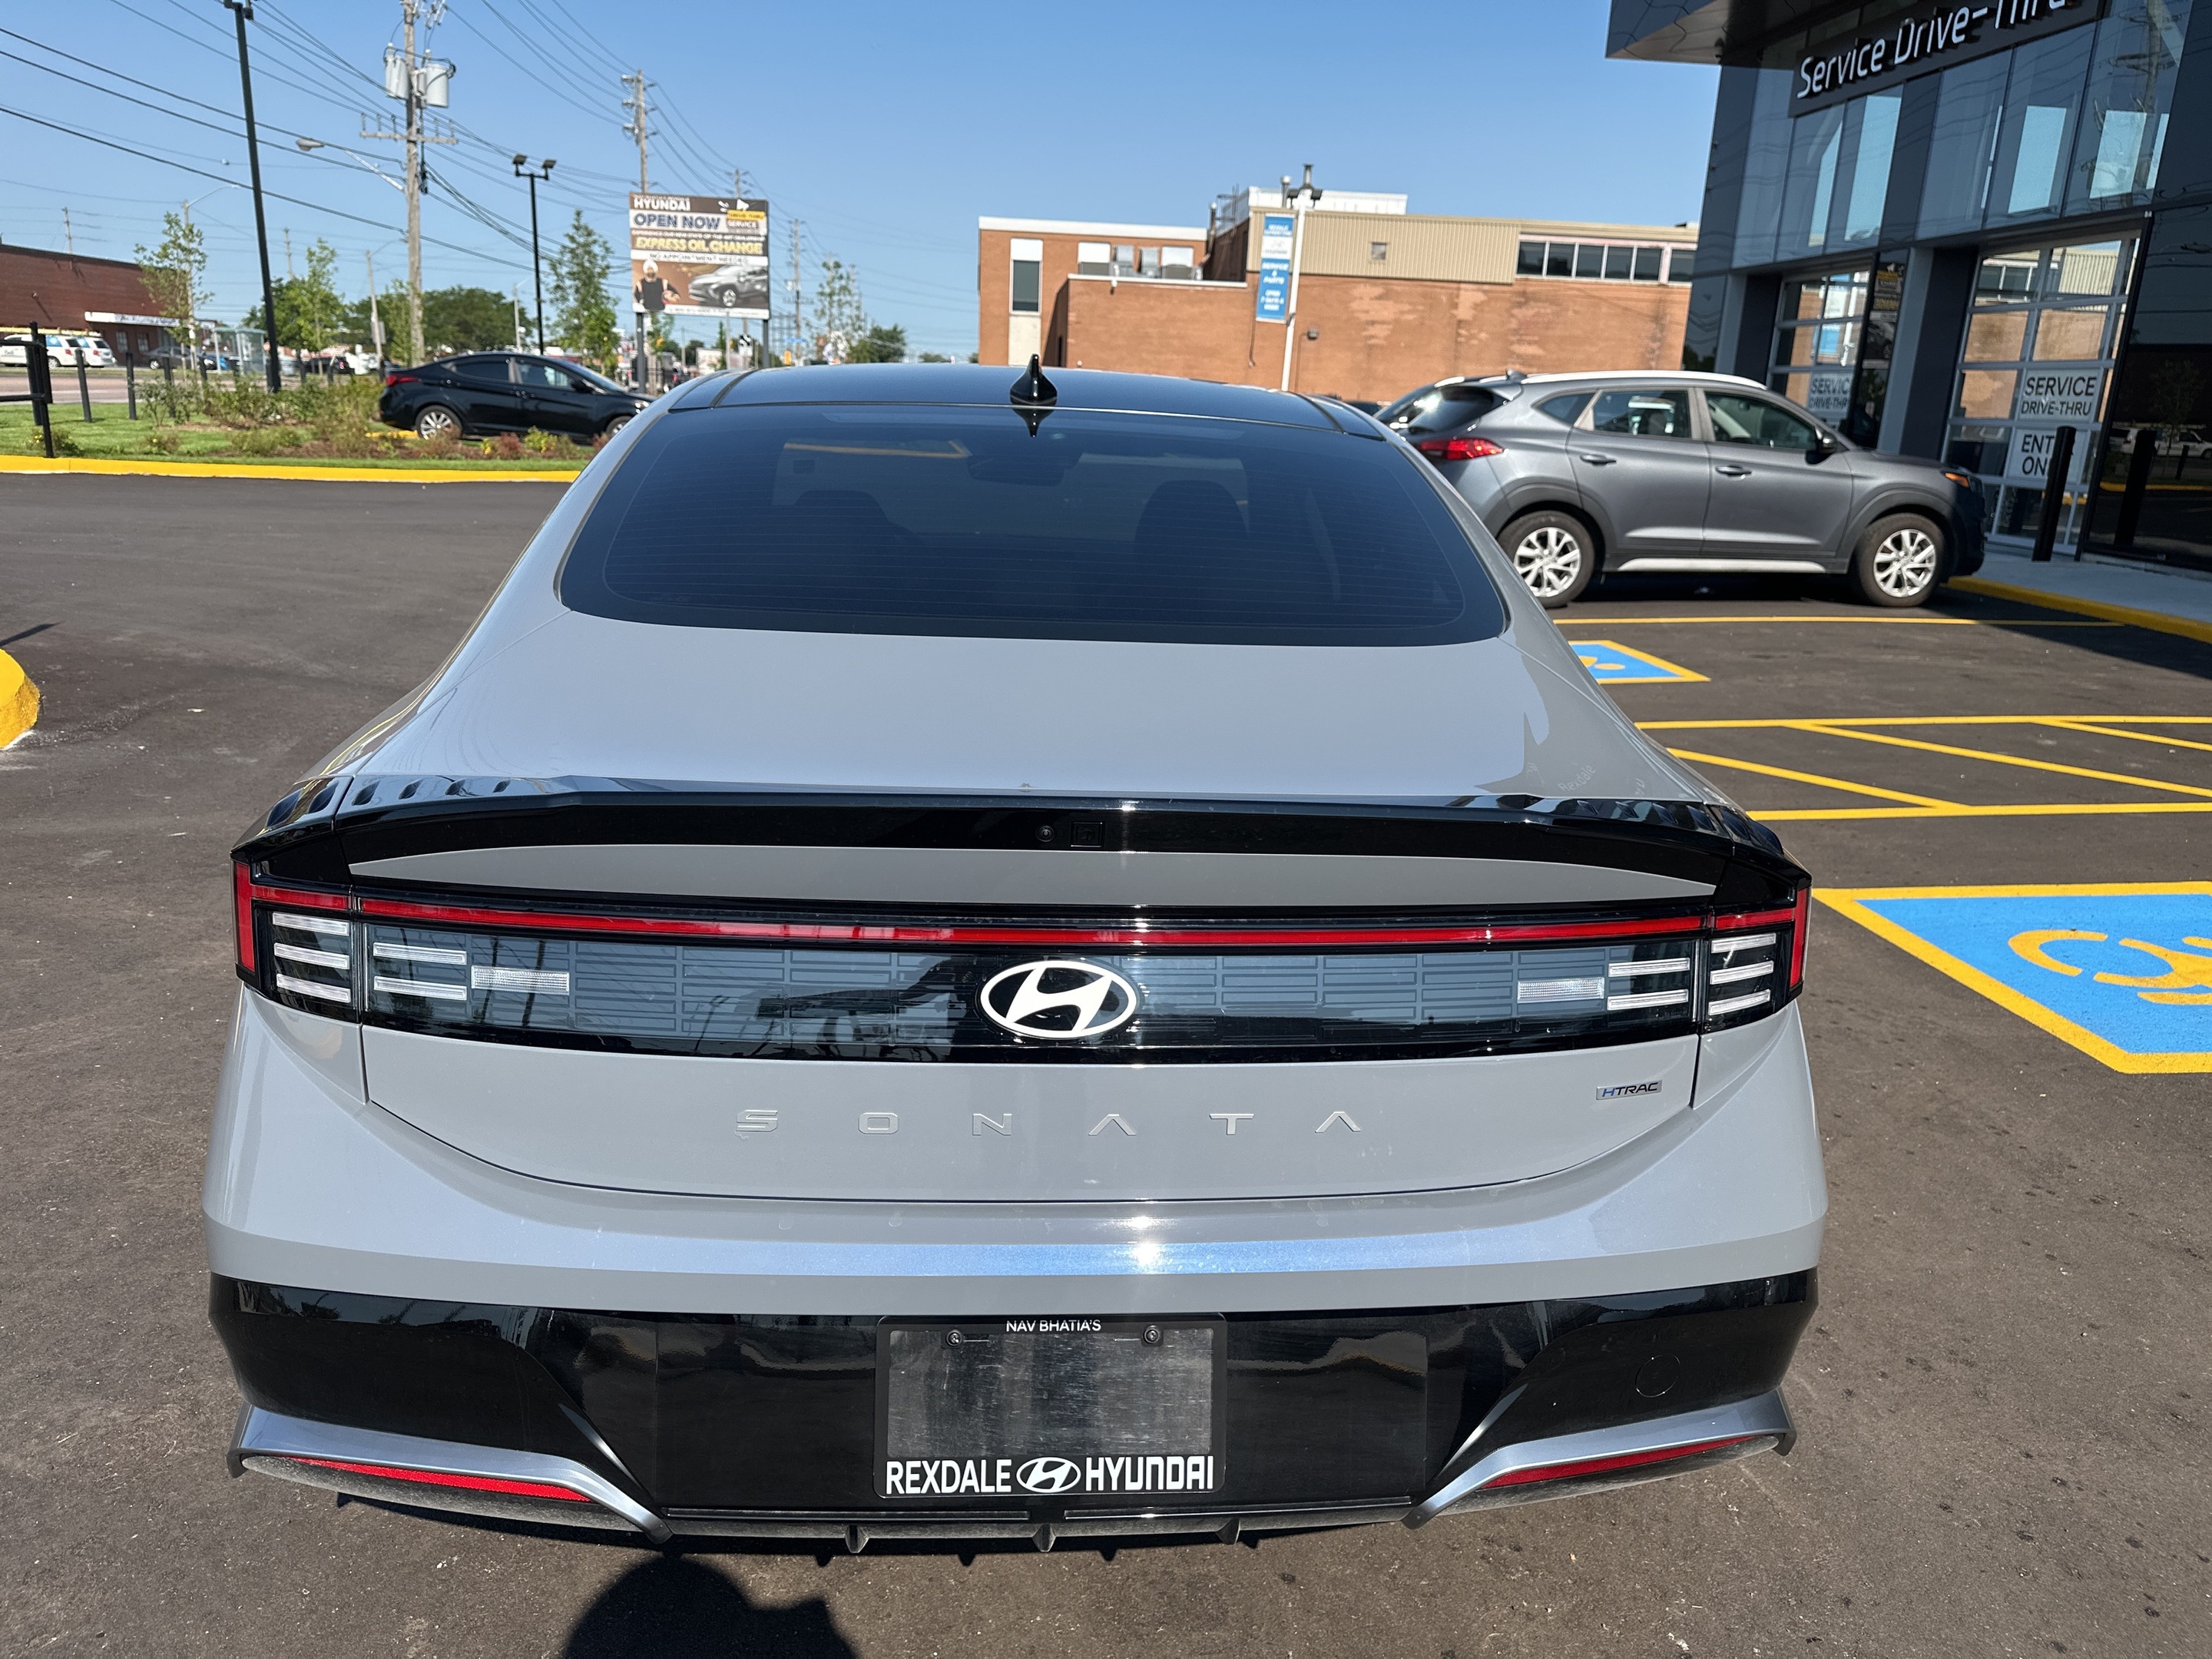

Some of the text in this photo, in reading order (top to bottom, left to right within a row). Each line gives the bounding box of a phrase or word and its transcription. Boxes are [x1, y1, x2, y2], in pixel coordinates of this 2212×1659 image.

[1796, 38, 1886, 98] Service
[634, 197, 690, 211] HYUNDAI
[634, 213, 677, 228] OPEN
[682, 216, 720, 230] NOW
[636, 237, 763, 255] EXPRESS OIL CHANGE
[1811, 377, 1849, 395] SERVIC
[2025, 376, 2098, 397] SERVICE
[1808, 396, 1848, 409] DRIVE-THR
[2021, 400, 2092, 416] DRIVE-THRU
[2021, 433, 2056, 455] ENT
[2022, 455, 2048, 476] ON
[1601, 1081, 1659, 1098] HTRAC
[736, 1109, 1362, 1135] SONATA
[1006, 1319, 1101, 1332] NAV BHATIA'S
[886, 1455, 1214, 1494] REXDALE HYUNDAI
